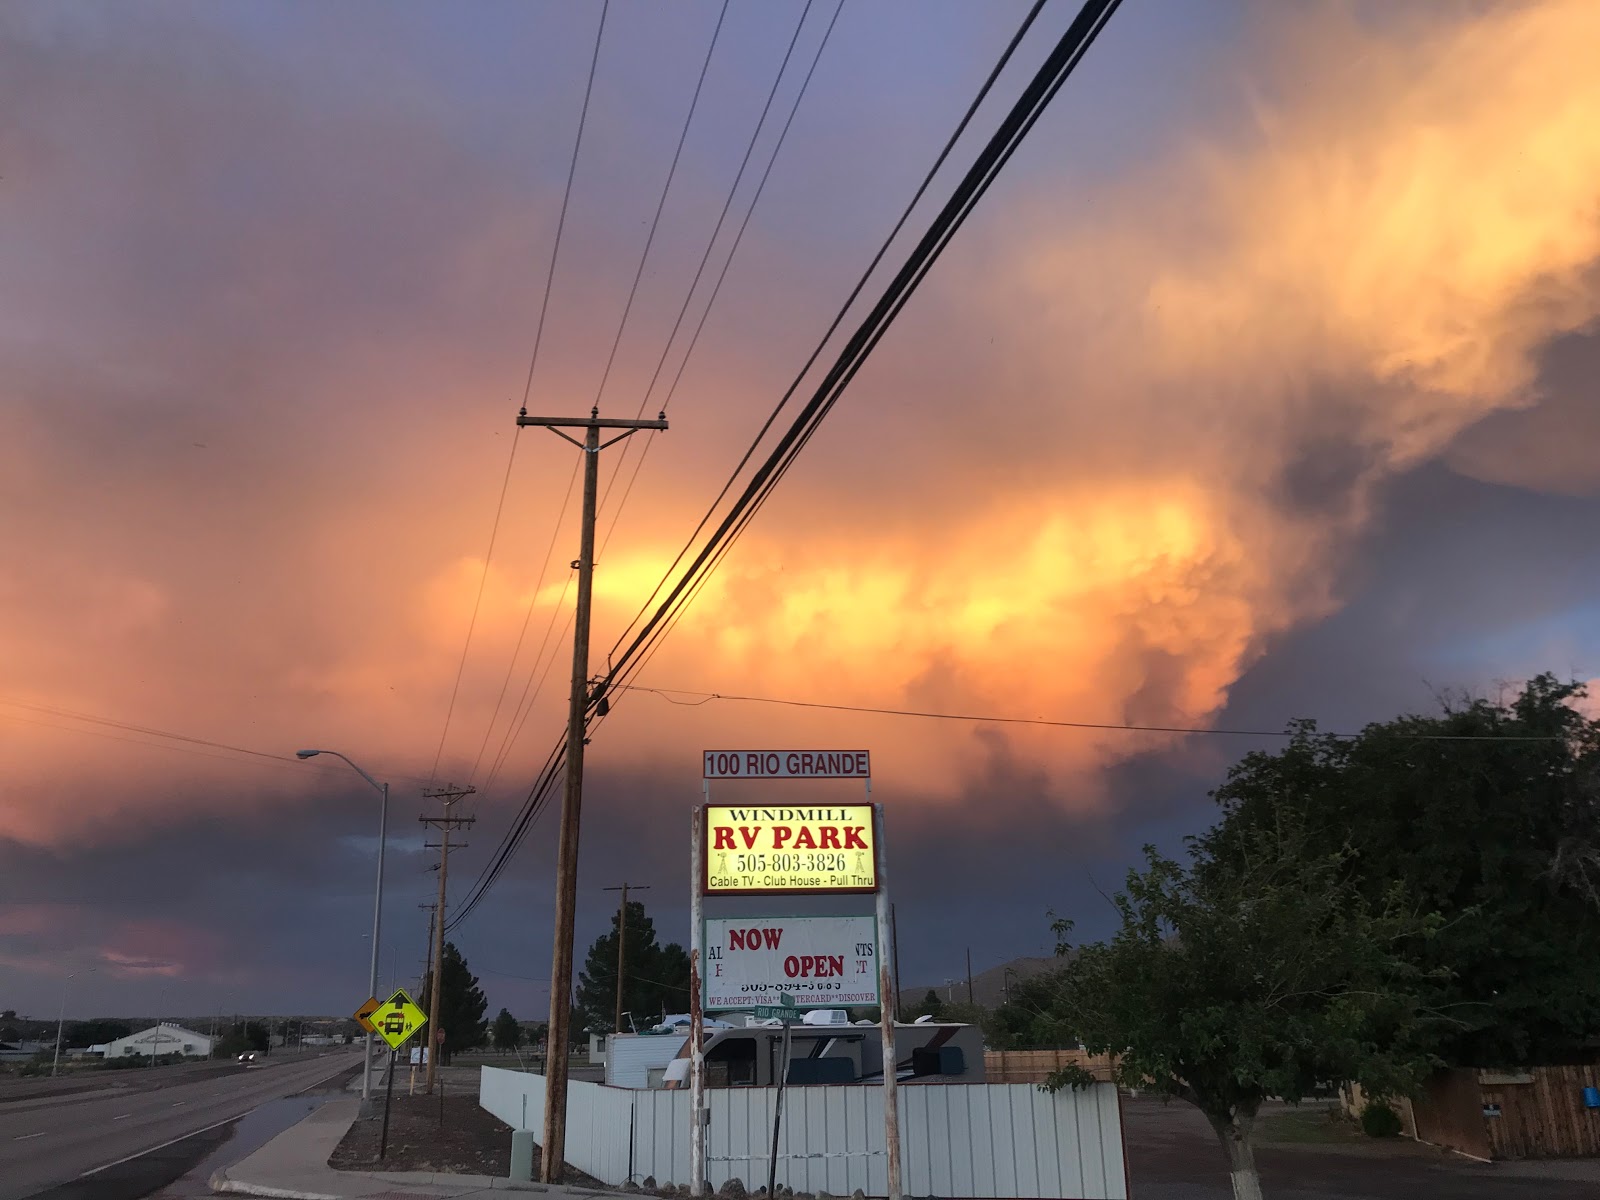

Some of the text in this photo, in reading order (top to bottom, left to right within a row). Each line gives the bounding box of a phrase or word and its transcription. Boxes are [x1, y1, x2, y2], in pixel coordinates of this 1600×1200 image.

[707, 753, 867, 775] 100 RIO GRANDE
[729, 809, 853, 821] WINDMILL
[713, 825, 869, 849] RV PARK
[737, 853, 846, 872] 505-803-3826
[710, 874, 873, 887] Cable TV Club House Pull Thru
[728, 928, 784, 951] NOW
[708, 946, 723, 960] AL
[783, 955, 845, 978] OPEN
[709, 996, 722, 1005] WE
[757, 1007, 797, 1019] RIO GRANDE
